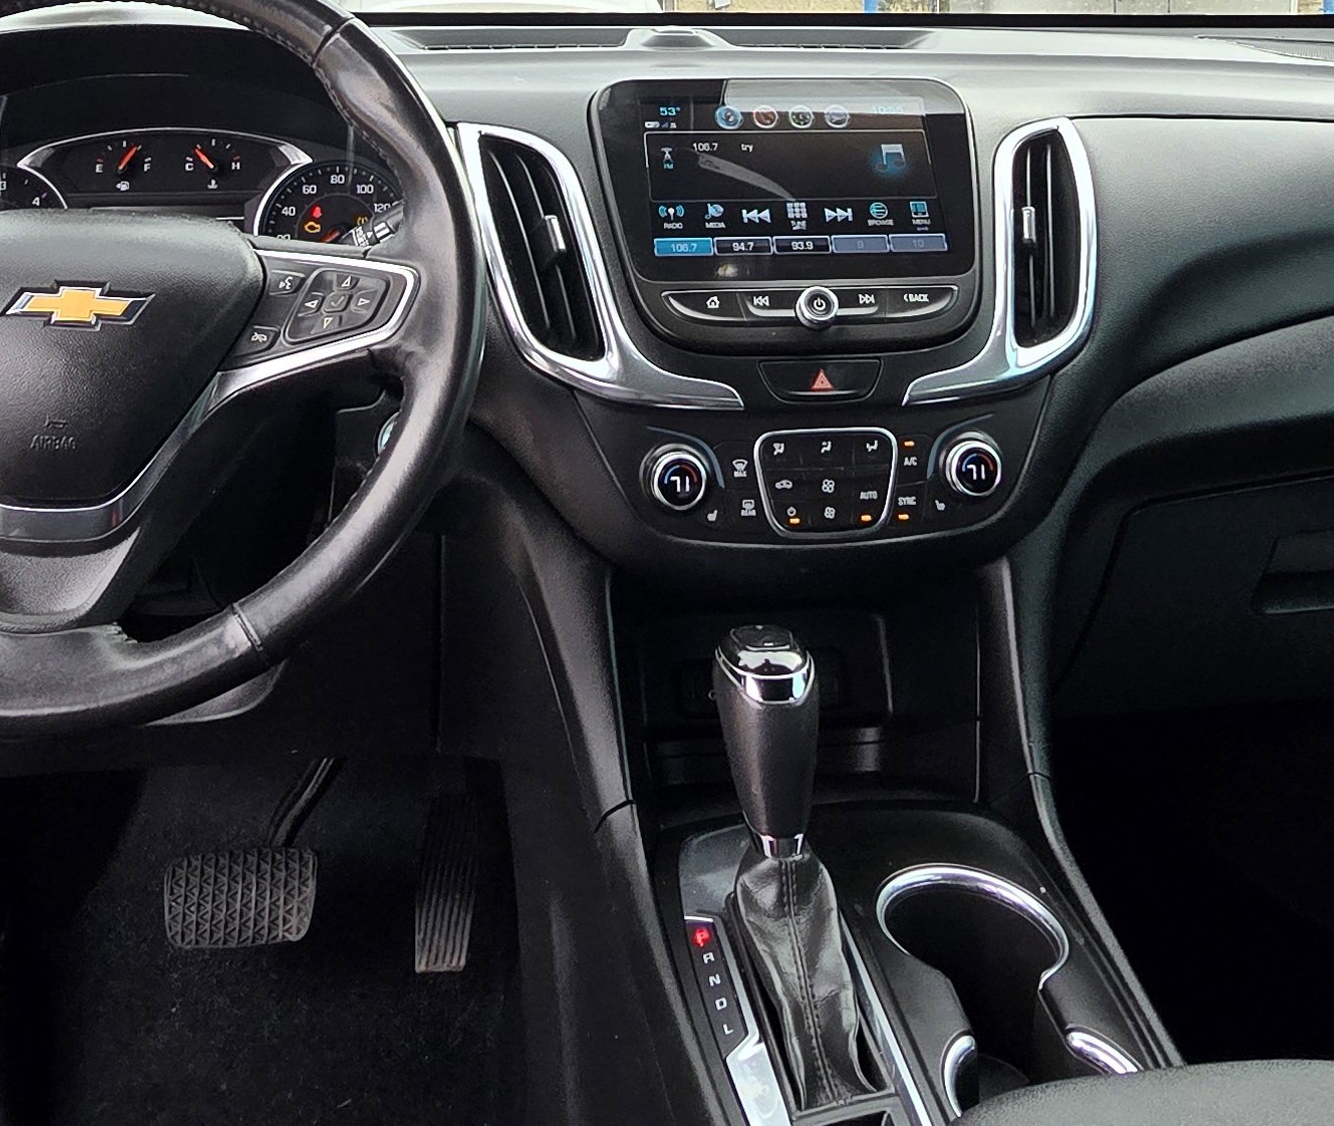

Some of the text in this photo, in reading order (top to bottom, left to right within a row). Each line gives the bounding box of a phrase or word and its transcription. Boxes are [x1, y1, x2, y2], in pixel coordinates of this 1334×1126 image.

[692, 142, 718, 152] 106.7
[96, 164, 103, 173] E
[143, 163, 151, 172] F
[185, 162, 194, 171] C
[231, 162, 241, 170] H
[330, 174, 345, 184] 80
[302, 184, 317, 194] 60
[356, 184, 374, 194] 100
[32, 196, 40, 206] 4
[281, 206, 296, 216] 40
[670, 242, 698, 253] 106.7
[732, 242, 755, 252] 94.7
[791, 240, 814, 251] 93.9
[903, 456, 918, 466] A/C
[966, 463, 986, 481] 71
[670, 475, 690, 493] 71
[860, 491, 878, 500] AUTO
[898, 496, 917, 506] SYNC
[708, 974, 721, 987] N
[715, 997, 728, 1011] D
[723, 1024, 734, 1035] L
